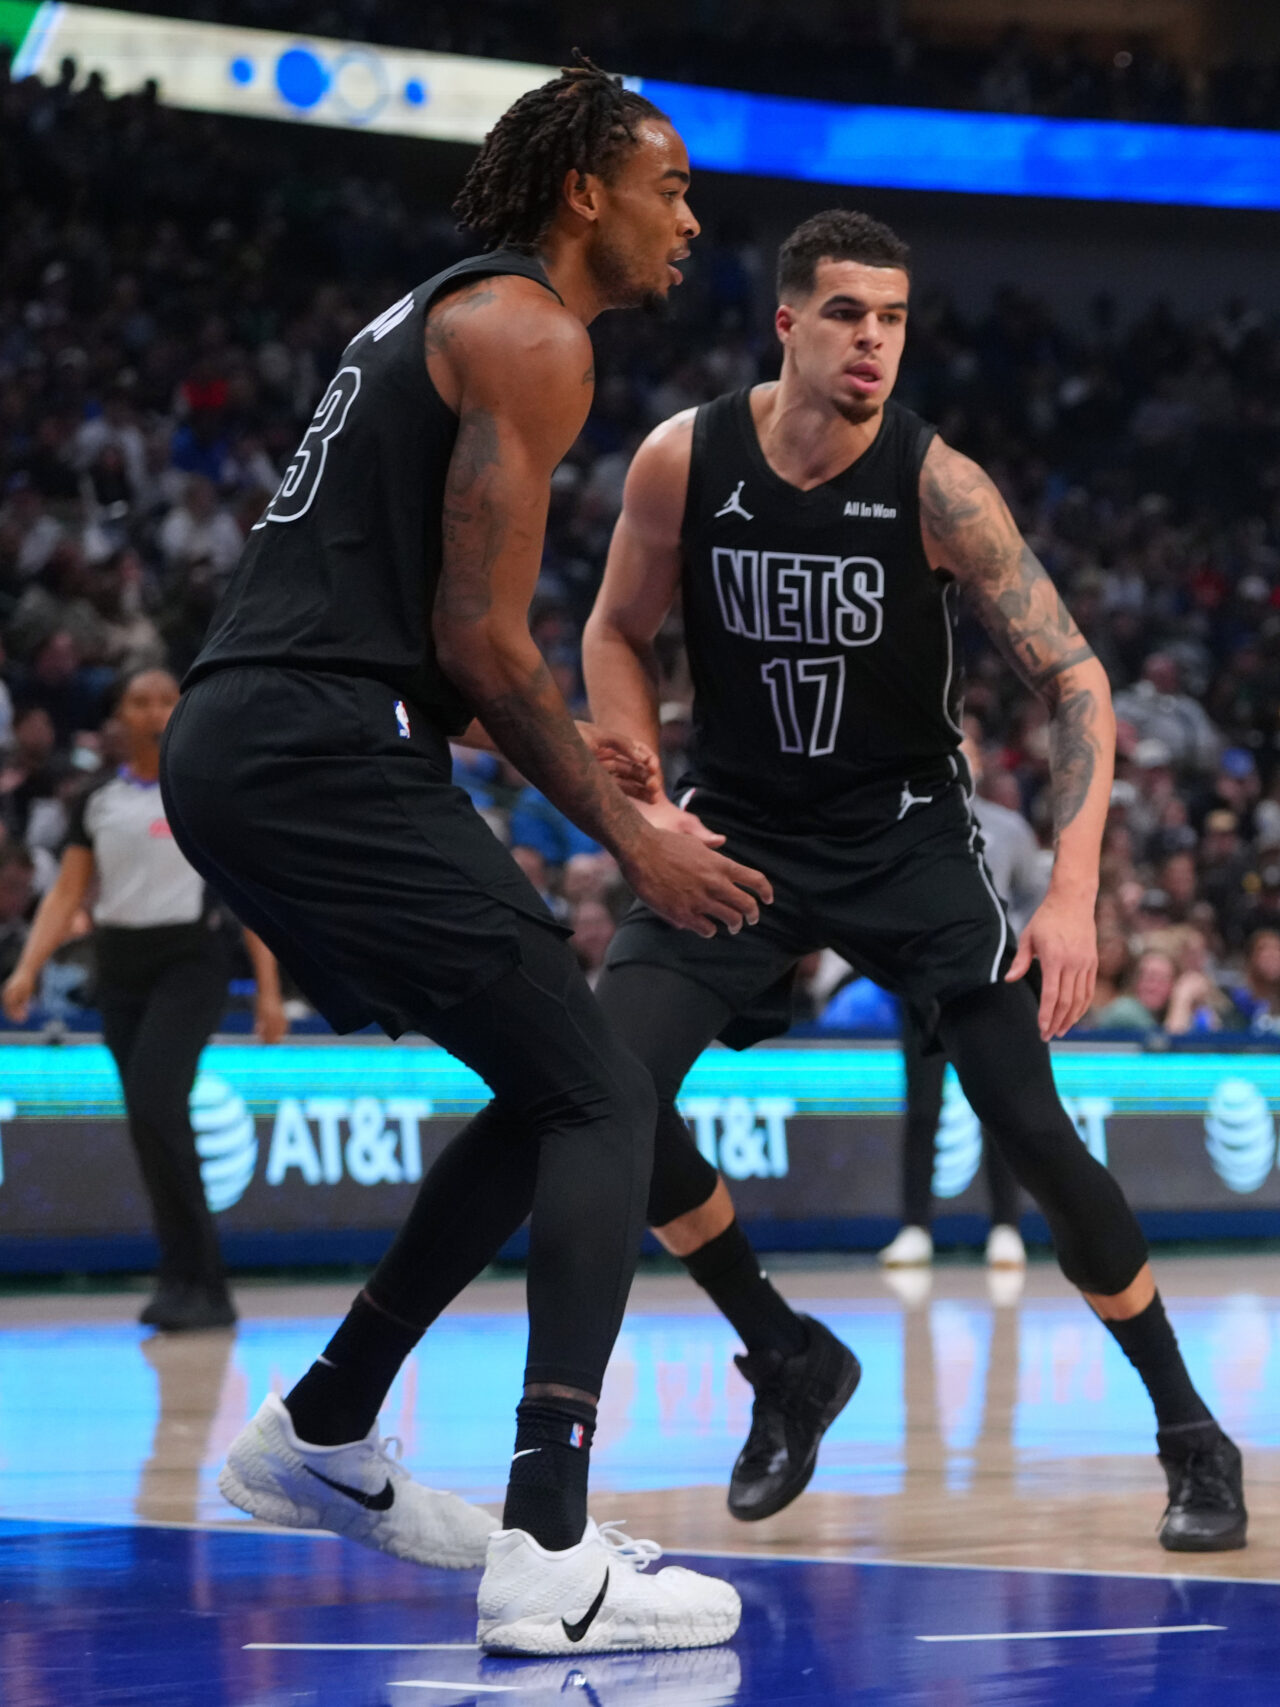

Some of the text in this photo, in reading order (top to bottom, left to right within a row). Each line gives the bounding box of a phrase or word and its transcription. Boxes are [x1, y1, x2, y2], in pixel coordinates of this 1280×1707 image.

[843, 500, 897, 519] All In Won
[711, 547, 885, 647] NETS
[760, 655, 846, 758] 17
[265, 1096, 434, 1186] AT&T
[677, 1096, 798, 1181] T&T
